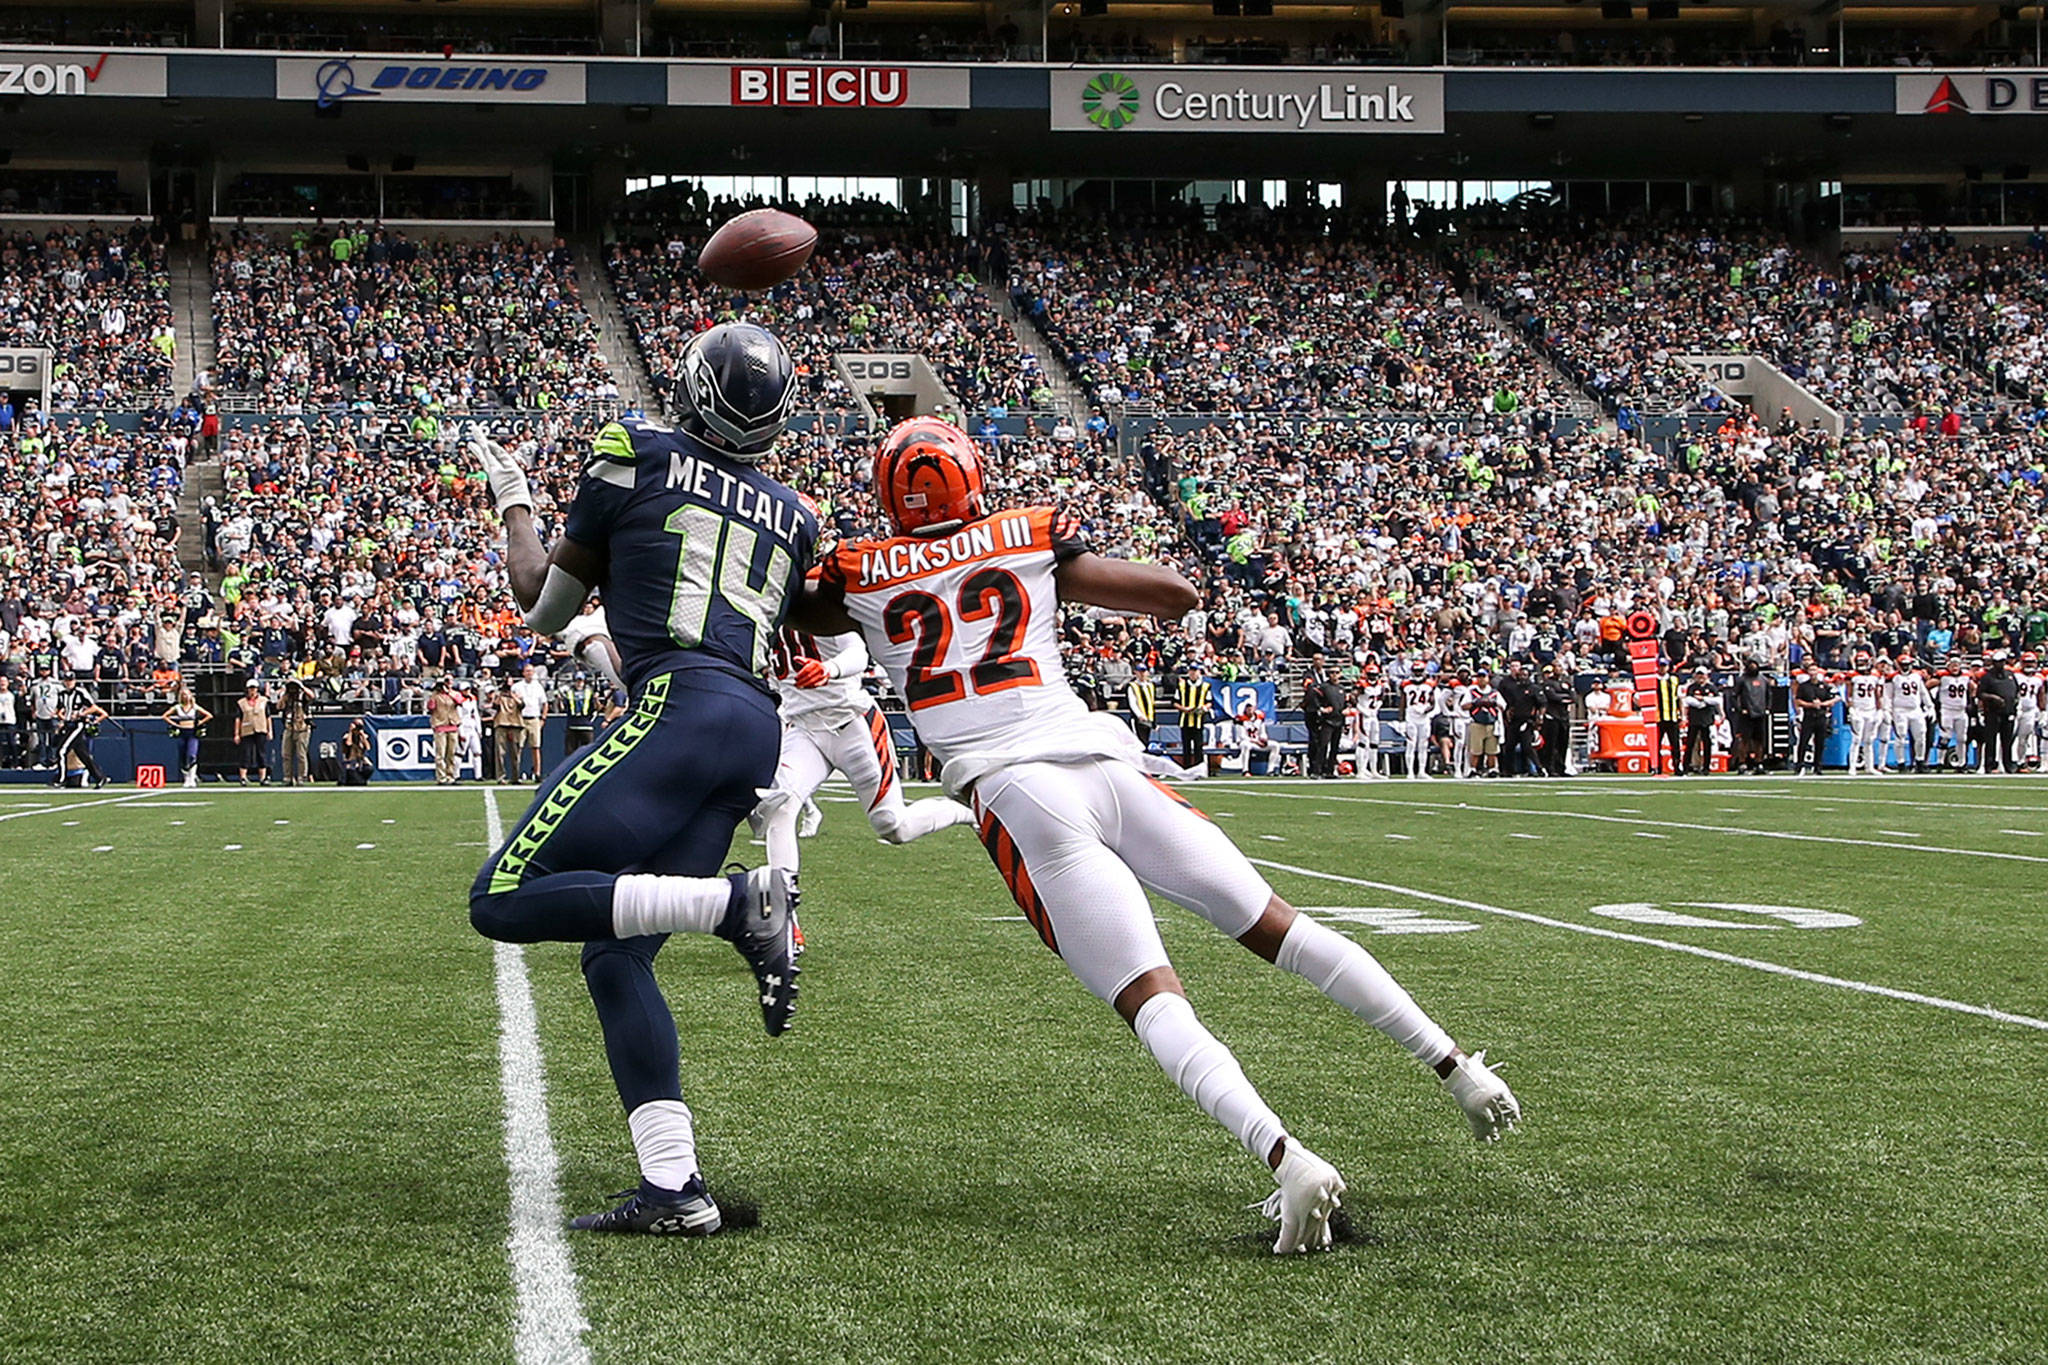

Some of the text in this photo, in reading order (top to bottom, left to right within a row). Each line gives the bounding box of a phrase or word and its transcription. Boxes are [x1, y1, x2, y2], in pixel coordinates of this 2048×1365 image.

[0, 64, 87, 95] zon
[371, 66, 548, 91] BOEING
[740, 70, 899, 102] BECU
[1987, 77, 2048, 111] DE
[1155, 83, 1415, 128] CenturyLink
[848, 360, 911, 379] 208
[665, 452, 806, 544] METCALF
[858, 515, 1033, 587] JACKSON III
[1422, 571, 1430, 582] 3
[663, 503, 793, 678] 14
[882, 566, 1044, 713] 22
[1135, 641, 1143, 655] 3
[1540, 637, 1554, 651] 12
[1890, 632, 1899, 645] 3
[39, 685, 50, 698] 12
[1408, 690, 1426, 706] 24
[1901, 681, 1918, 696] 99
[1220, 686, 1258, 719] 12
[1623, 733, 1648, 747] GA
[1627, 759, 1639, 771] G
[140, 768, 160, 788] 20
